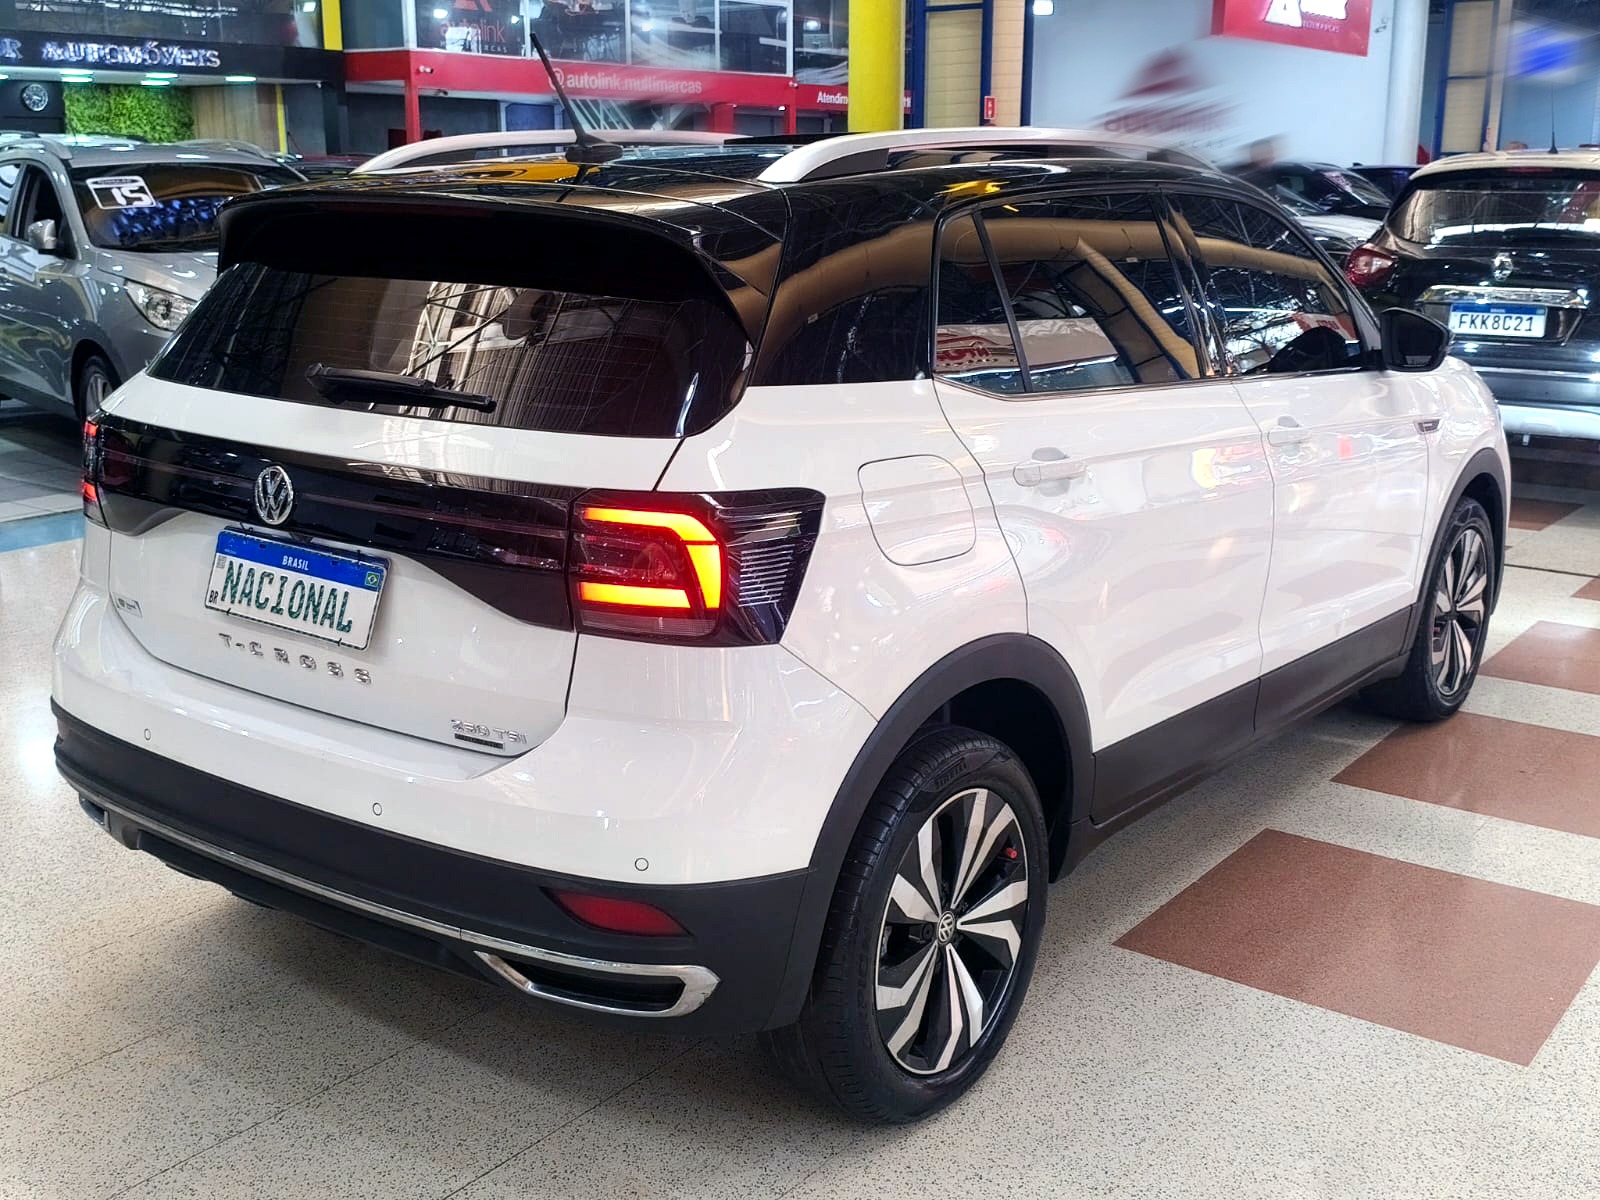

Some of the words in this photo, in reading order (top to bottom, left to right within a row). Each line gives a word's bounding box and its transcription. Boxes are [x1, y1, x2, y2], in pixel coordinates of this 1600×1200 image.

[816, 91, 849, 105] Atendim
[1458, 313, 1534, 332] FKK8C21
[281, 554, 310, 571] BRASIL
[208, 589, 219, 604] BR
[220, 560, 353, 633] NACIONAL
[218, 632, 373, 684] T-CROSS
